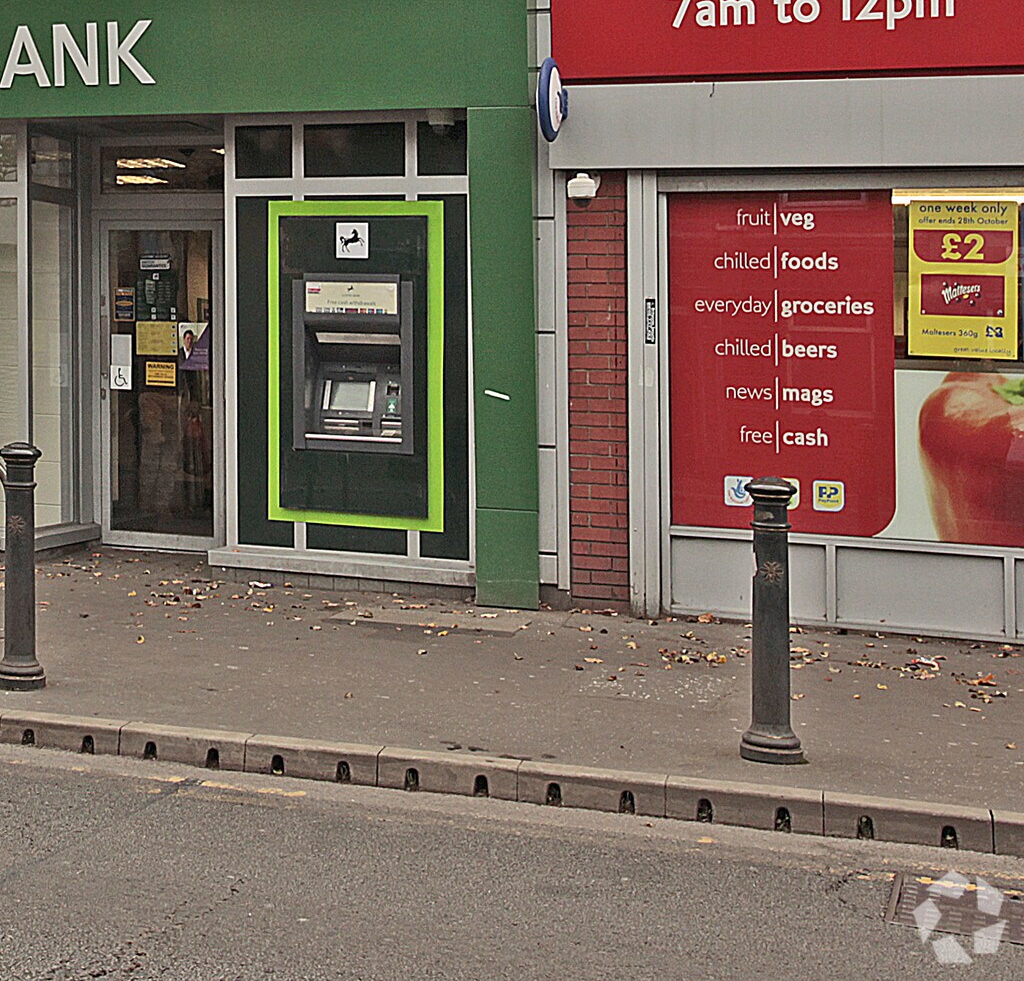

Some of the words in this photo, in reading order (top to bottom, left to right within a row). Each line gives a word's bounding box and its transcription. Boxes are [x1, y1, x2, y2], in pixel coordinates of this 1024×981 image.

[737, 208, 771, 226] fruit
[780, 212, 815, 230] veg
[919, 204, 942, 213] one
[946, 202, 978, 213] week
[981, 202, 1008, 216] only
[977, 217, 1008, 225] October
[941, 233, 985, 260] £2
[714, 252, 771, 270] chilled
[781, 251, 839, 270] foods
[941, 285, 981, 305] Maltesers
[694, 296, 772, 316] everyday
[781, 295, 874, 318] groceries
[958, 330, 979, 338] 360g
[714, 338, 772, 356] chilled
[782, 339, 838, 358] beers
[726, 386, 772, 400] news
[782, 387, 834, 406] mags
[740, 425, 773, 444] free
[783, 428, 828, 447] cash
